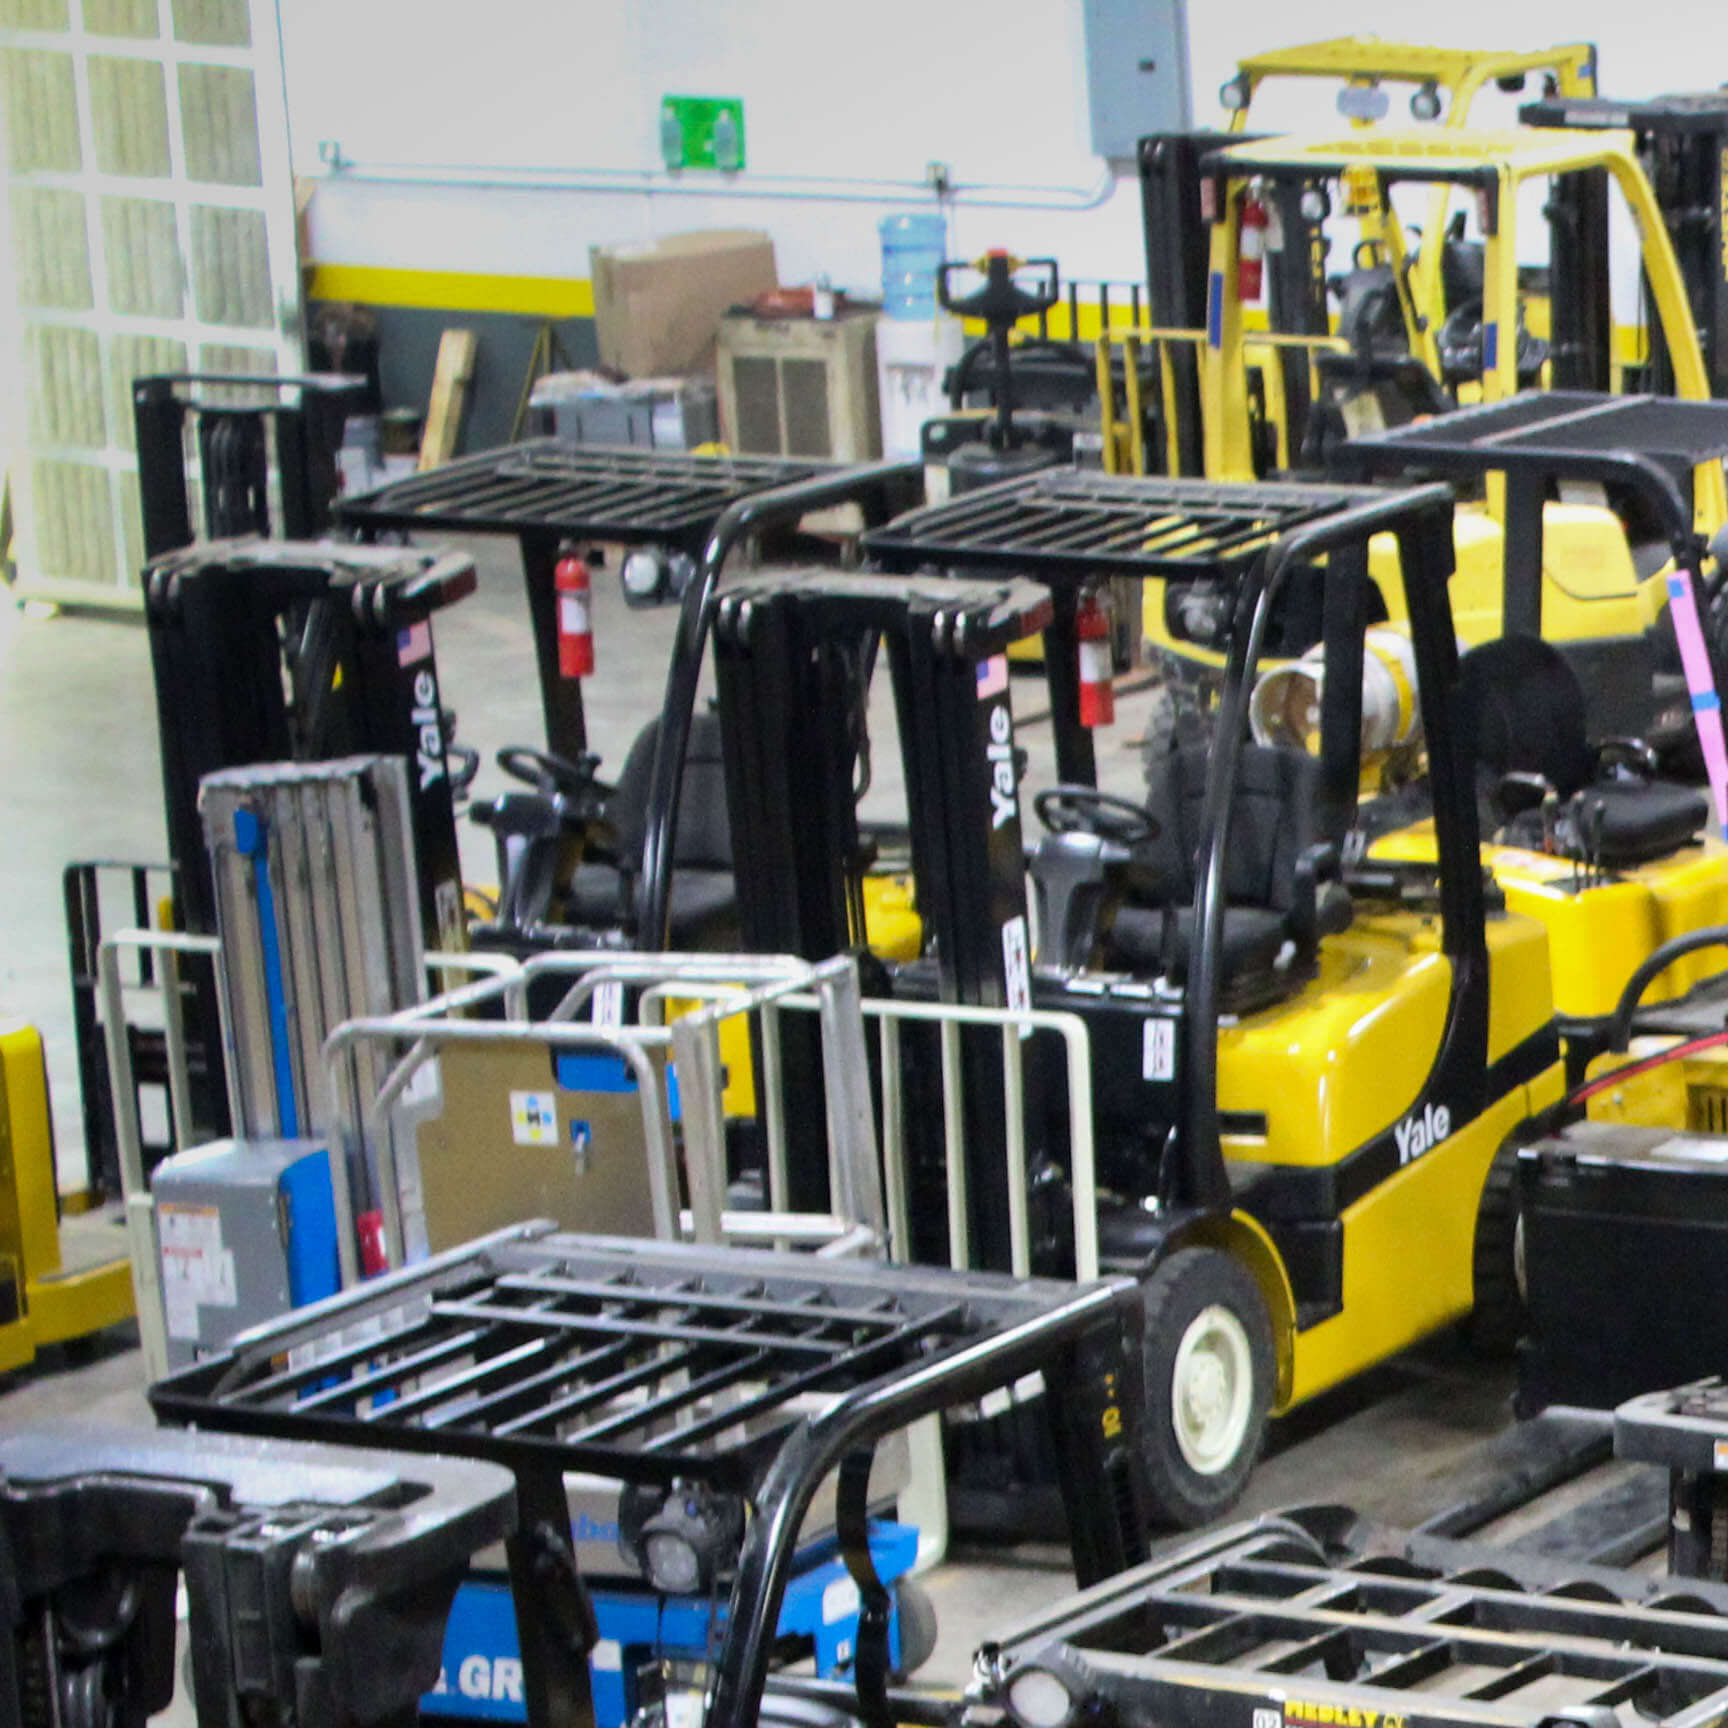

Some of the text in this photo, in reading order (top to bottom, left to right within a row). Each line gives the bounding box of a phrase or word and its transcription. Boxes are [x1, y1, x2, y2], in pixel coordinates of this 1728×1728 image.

[411, 668, 445, 792] Yale
[987, 704, 1016, 830] Yale
[1394, 1101, 1450, 1166] Yale
[1283, 1700, 1379, 1728] MEDLEY
